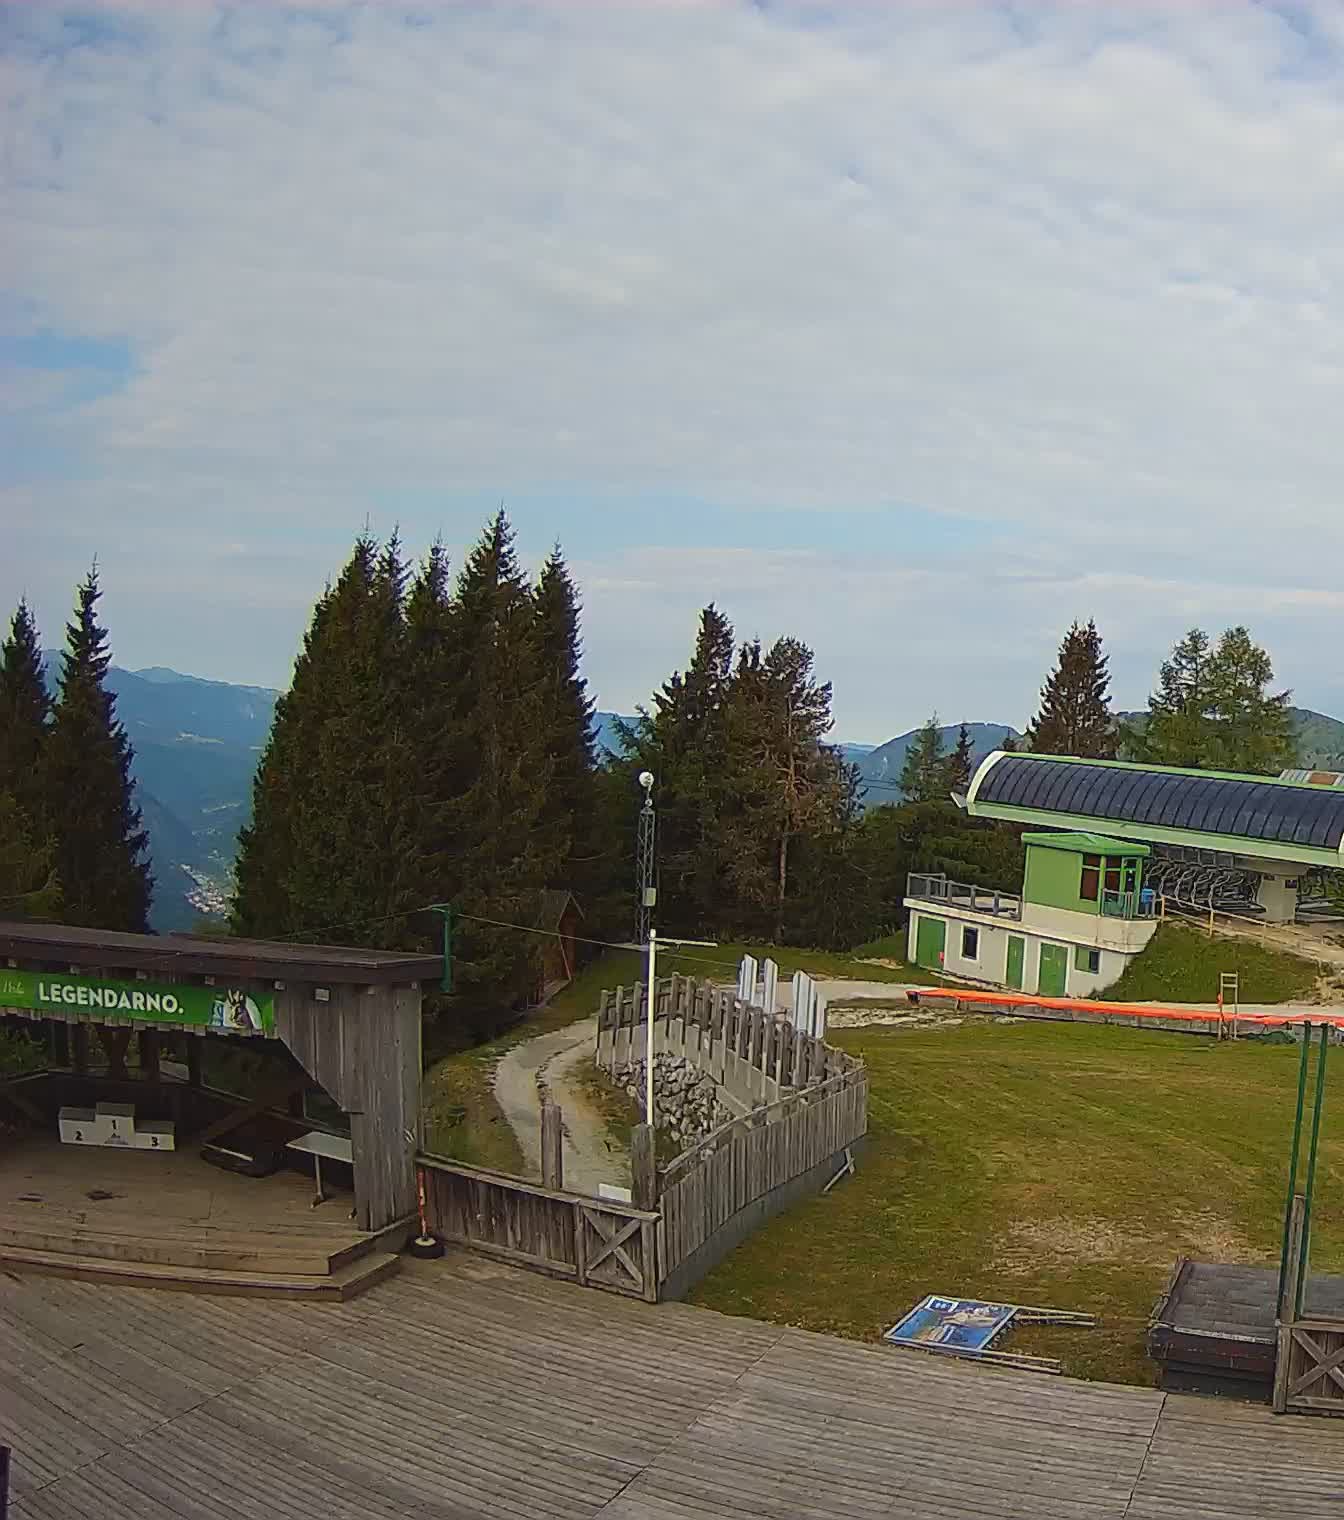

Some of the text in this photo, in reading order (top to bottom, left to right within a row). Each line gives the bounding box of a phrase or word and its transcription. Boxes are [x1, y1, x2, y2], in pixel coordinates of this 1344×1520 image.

[38, 981, 184, 1014] LEGENDARNO.
[74, 1130, 83, 1141] 2
[151, 1136, 159, 1147] 3
